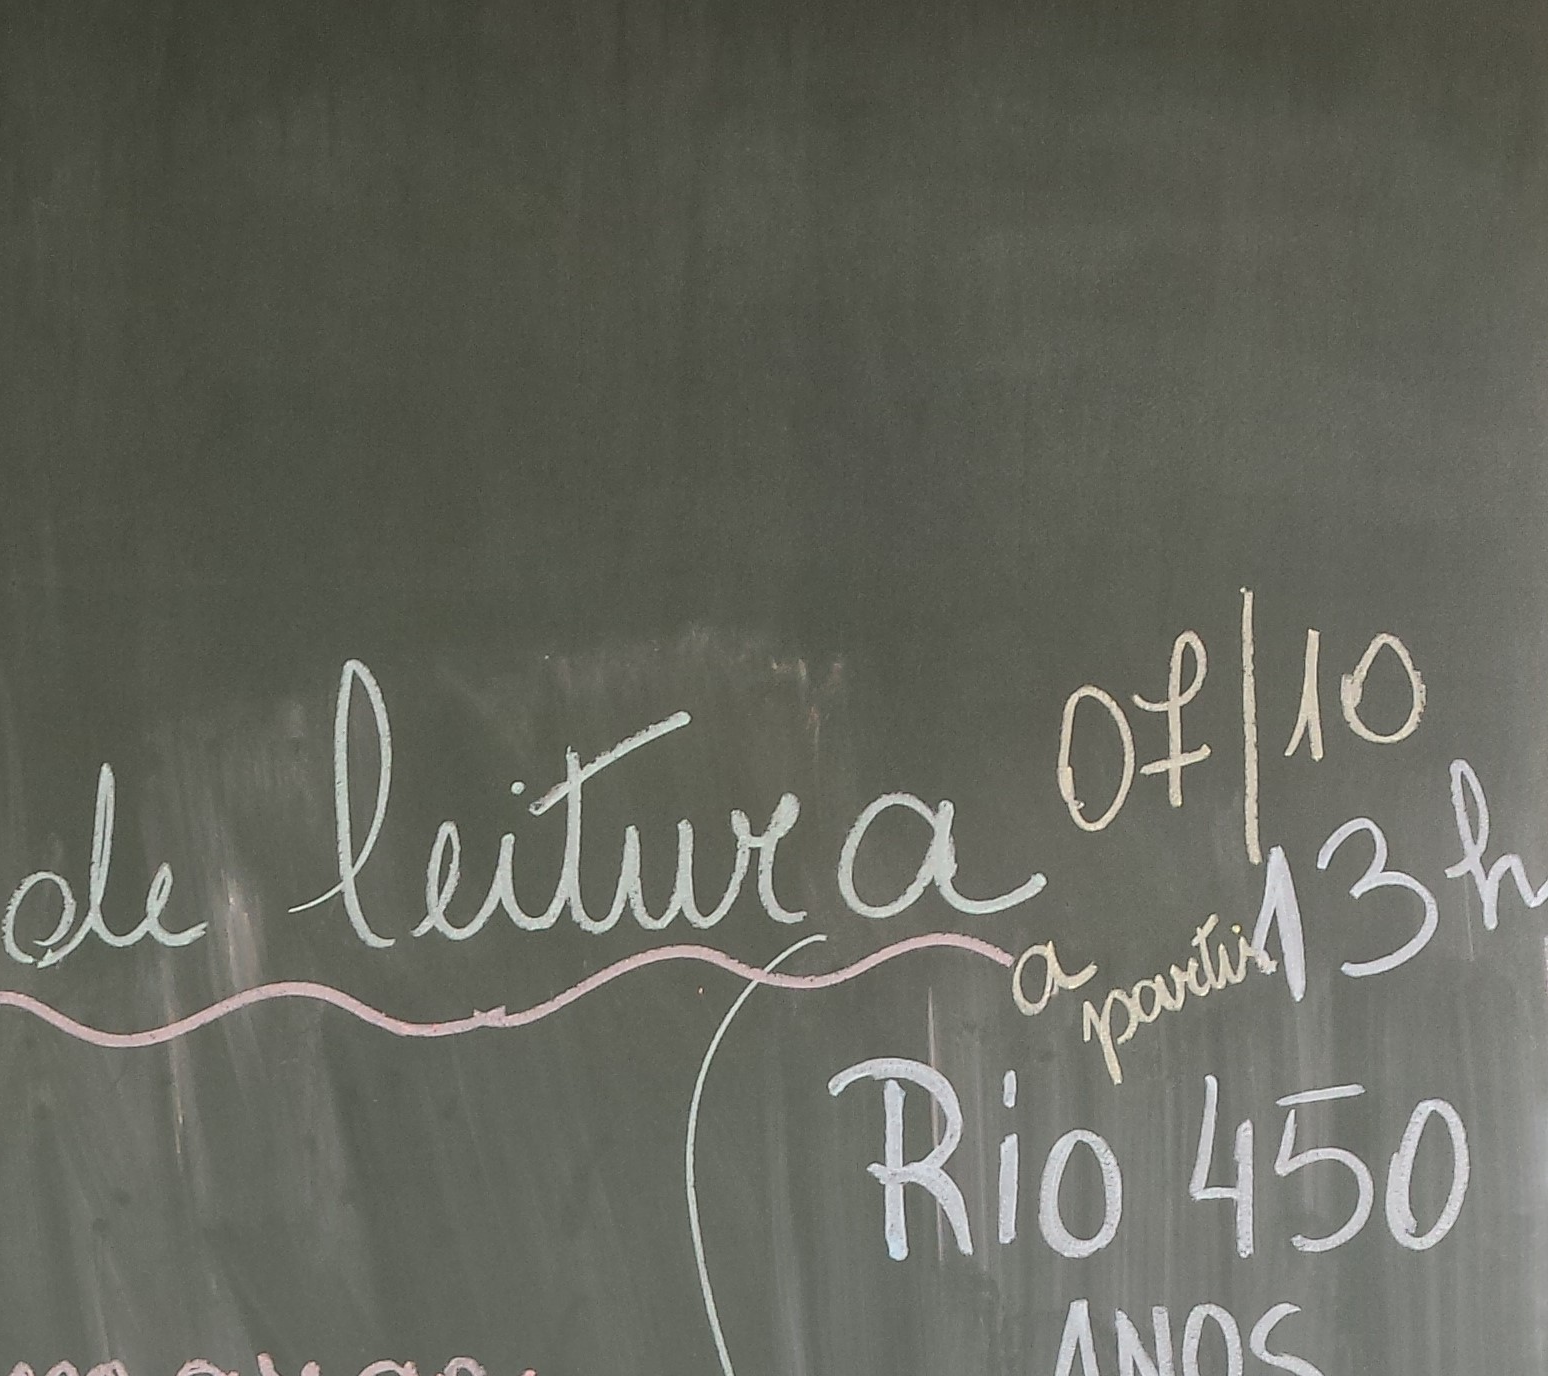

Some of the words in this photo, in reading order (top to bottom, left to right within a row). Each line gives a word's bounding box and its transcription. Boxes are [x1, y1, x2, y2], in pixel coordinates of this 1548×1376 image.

[2, 763, 207, 968] de
[289, 659, 1047, 948] leitura
[1058, 587, 1427, 865] 07/10
[1012, 940, 1098, 1017] a
[828, 1057, 1124, 1261] Rio
[1190, 1074, 1472, 1260] 450
